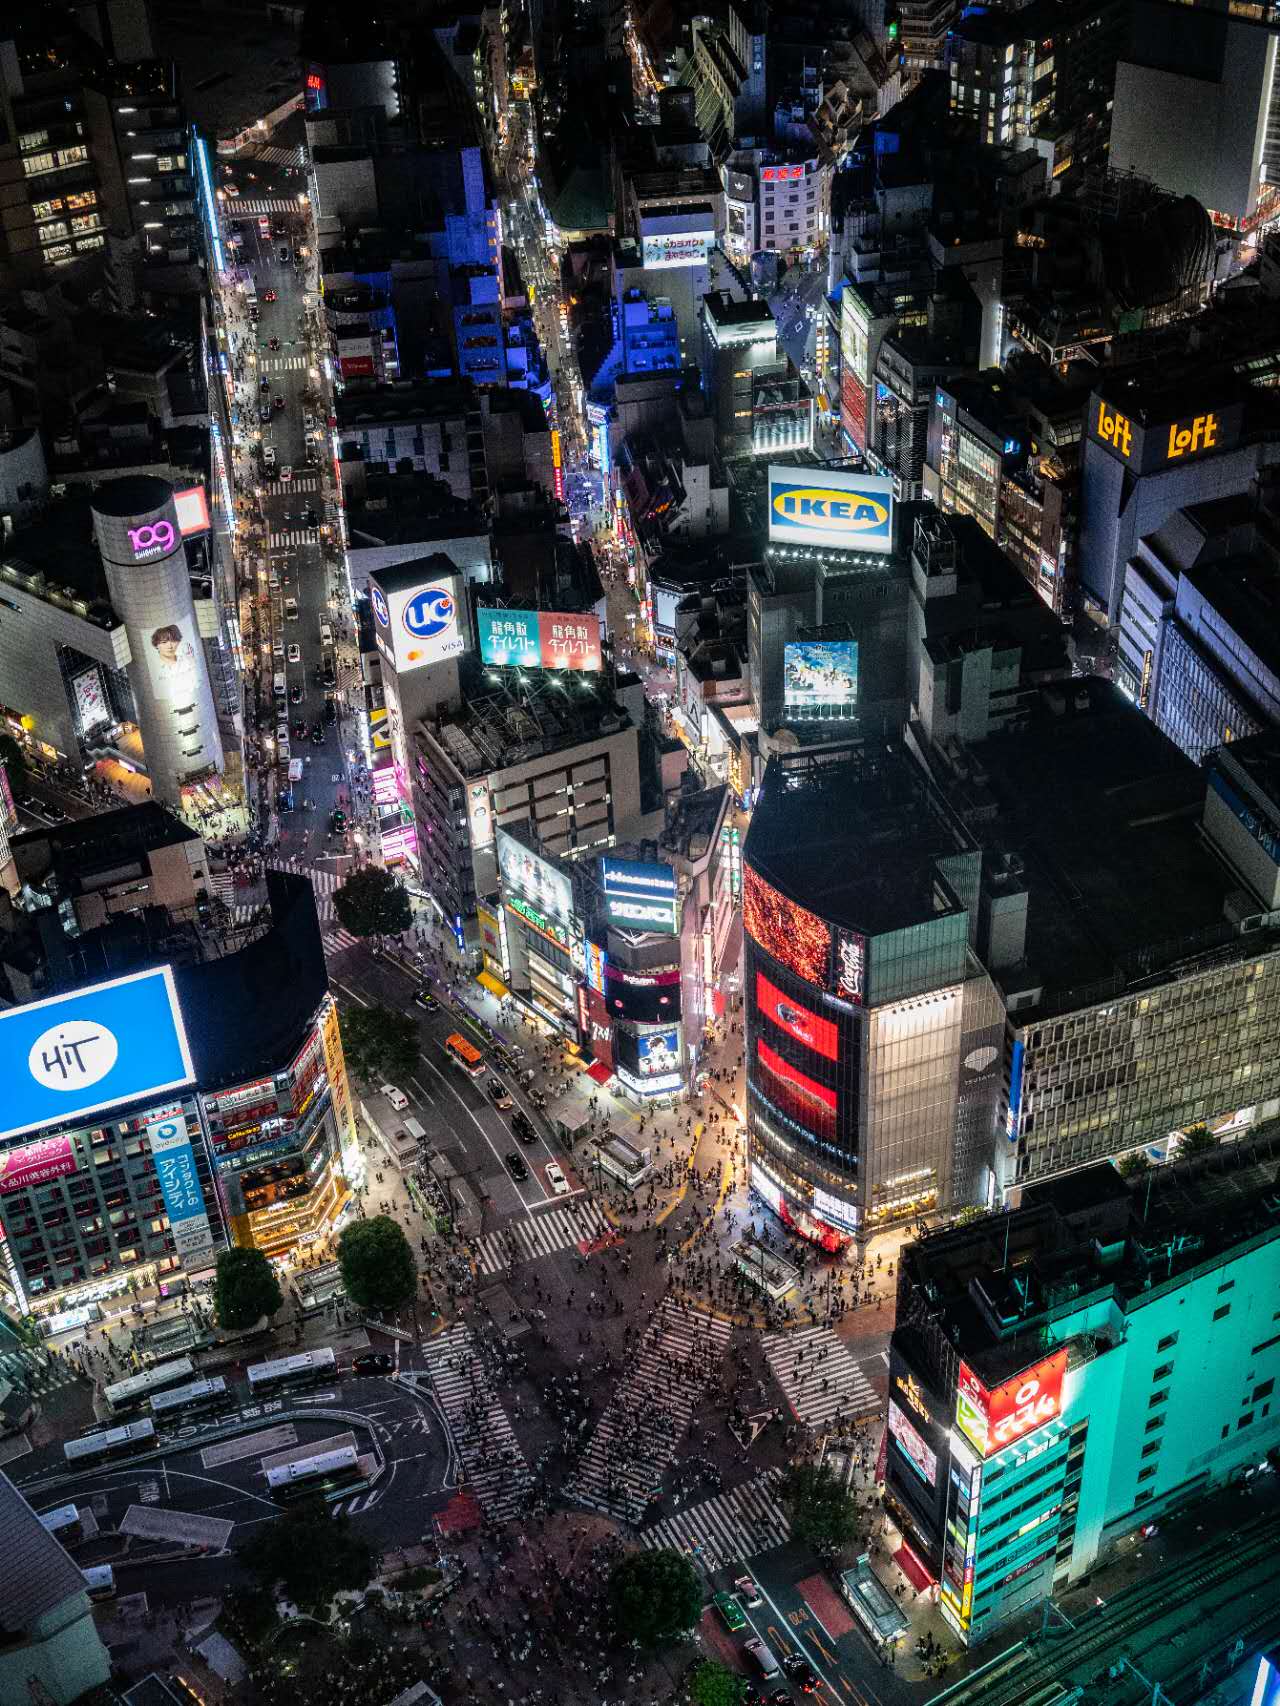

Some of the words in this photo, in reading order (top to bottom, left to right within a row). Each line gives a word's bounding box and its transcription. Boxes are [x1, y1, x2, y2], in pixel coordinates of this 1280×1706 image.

[784, 497, 879, 522] IKEA
[128, 521, 174, 551] 109
[492, 621, 527, 635] 龍角散
[552, 625, 588, 640] 龍角散
[441, 640, 463, 651] VISA
[8, 1163, 72, 1188] 品川美容外科
[161, 1160, 185, 1210] アイシティ
[994, 1395, 1056, 1443] アコム
